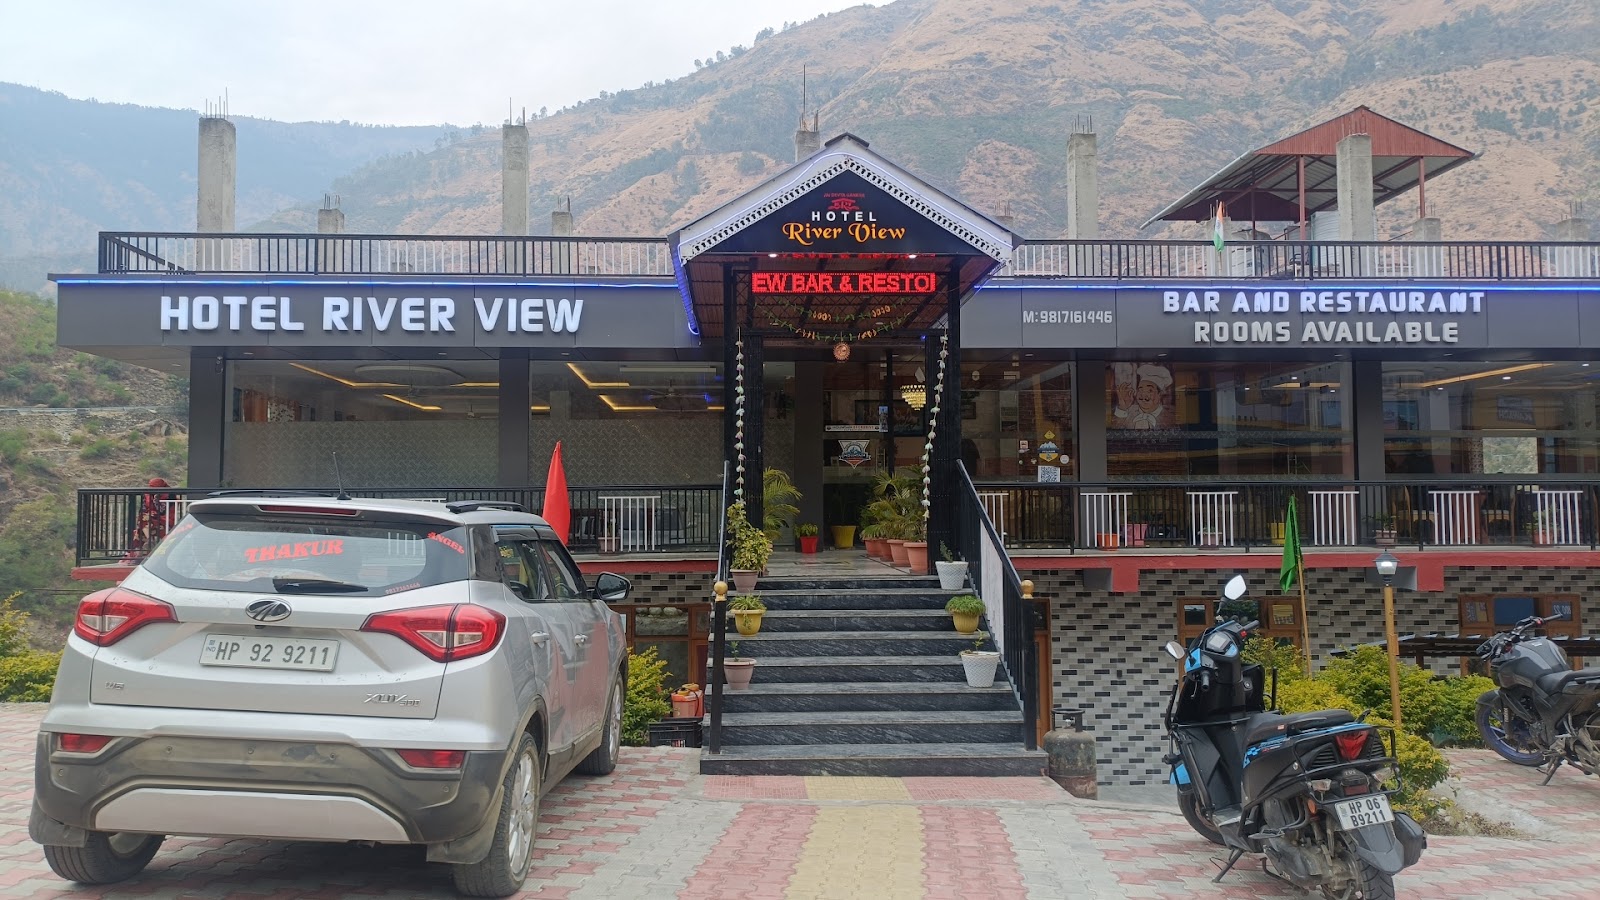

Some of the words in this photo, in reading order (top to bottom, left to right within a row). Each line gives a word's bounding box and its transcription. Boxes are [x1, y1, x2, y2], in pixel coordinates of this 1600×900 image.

[811, 211, 877, 222] HOTEL
[782, 222, 842, 246] River
[848, 222, 906, 243] View
[791, 273, 835, 293] BAR
[839, 274, 854, 293] &
[1162, 291, 1220, 313] BAR
[1231, 291, 1290, 313] AND
[1300, 291, 1486, 314] RESTAURANT
[160, 296, 305, 332] HOTEL
[322, 296, 456, 333] RIVER
[473, 297, 584, 334] VIEW
[1022, 309, 1114, 325] M:9817161446
[1194, 320, 1292, 344] ROOMS
[1301, 320, 1459, 344] AVAILABLE
[244, 539, 345, 565] THAKUR
[427, 531, 465, 555] ANGEL
[215, 641, 241, 660] HP
[249, 643, 274, 663] 92
[282, 645, 329, 666] 9211
[1348, 801, 1362, 815] HP
[1365, 797, 1381, 812] 06
[1350, 809, 1387, 827] B9211
